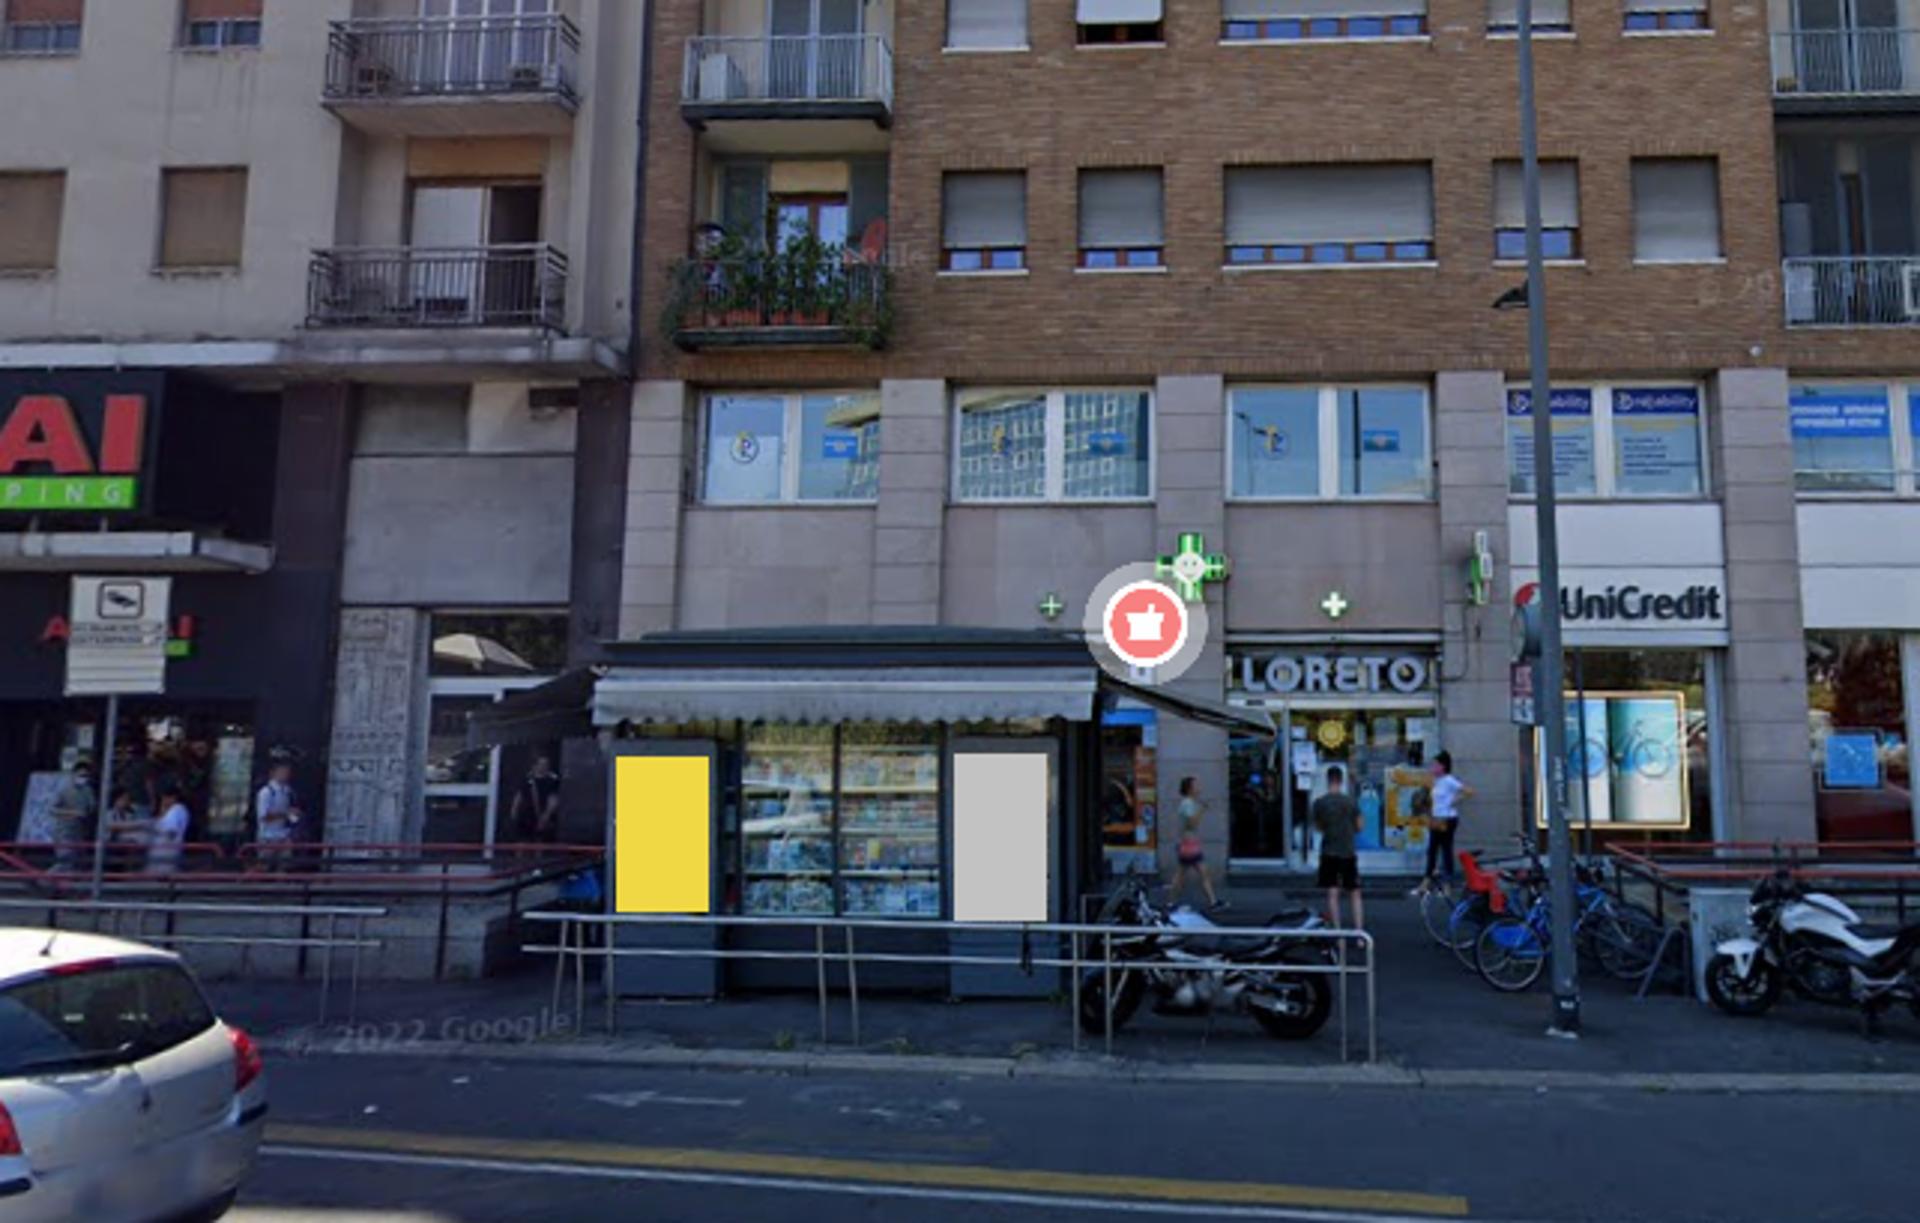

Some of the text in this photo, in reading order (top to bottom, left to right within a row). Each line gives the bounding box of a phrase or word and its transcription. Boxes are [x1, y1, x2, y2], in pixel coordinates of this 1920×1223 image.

[5, 482, 121, 501] PING
[1561, 586, 1721, 620] UniCredit
[1241, 655, 1426, 693] LORETO
